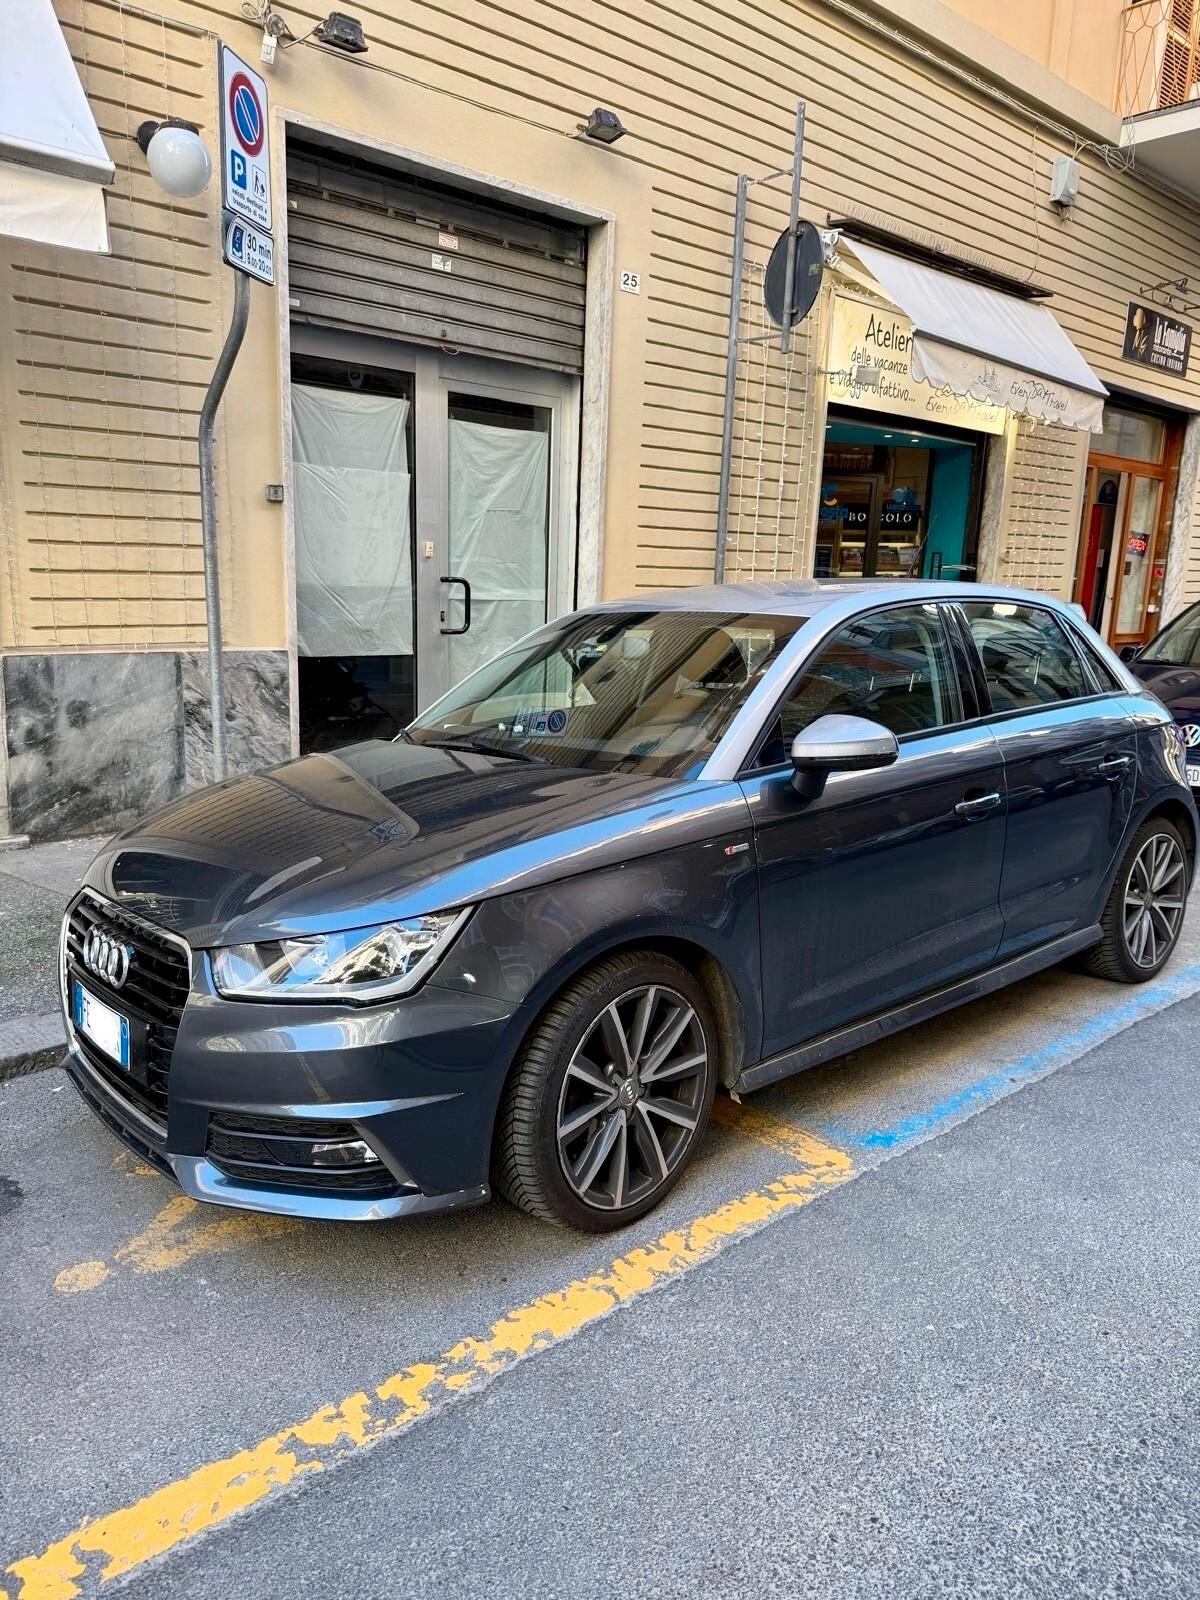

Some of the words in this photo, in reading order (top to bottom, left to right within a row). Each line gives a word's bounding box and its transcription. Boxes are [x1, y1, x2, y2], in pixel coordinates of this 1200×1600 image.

[234, 155, 244, 182] P
[246, 233, 257, 252] 30
[258, 244, 272, 261] min
[623, 273, 638, 287] 25
[865, 313, 914, 353] Atelier
[850, 346, 871, 367] delle
[874, 356, 908, 375] vacanze
[829, 374, 835, 385] e
